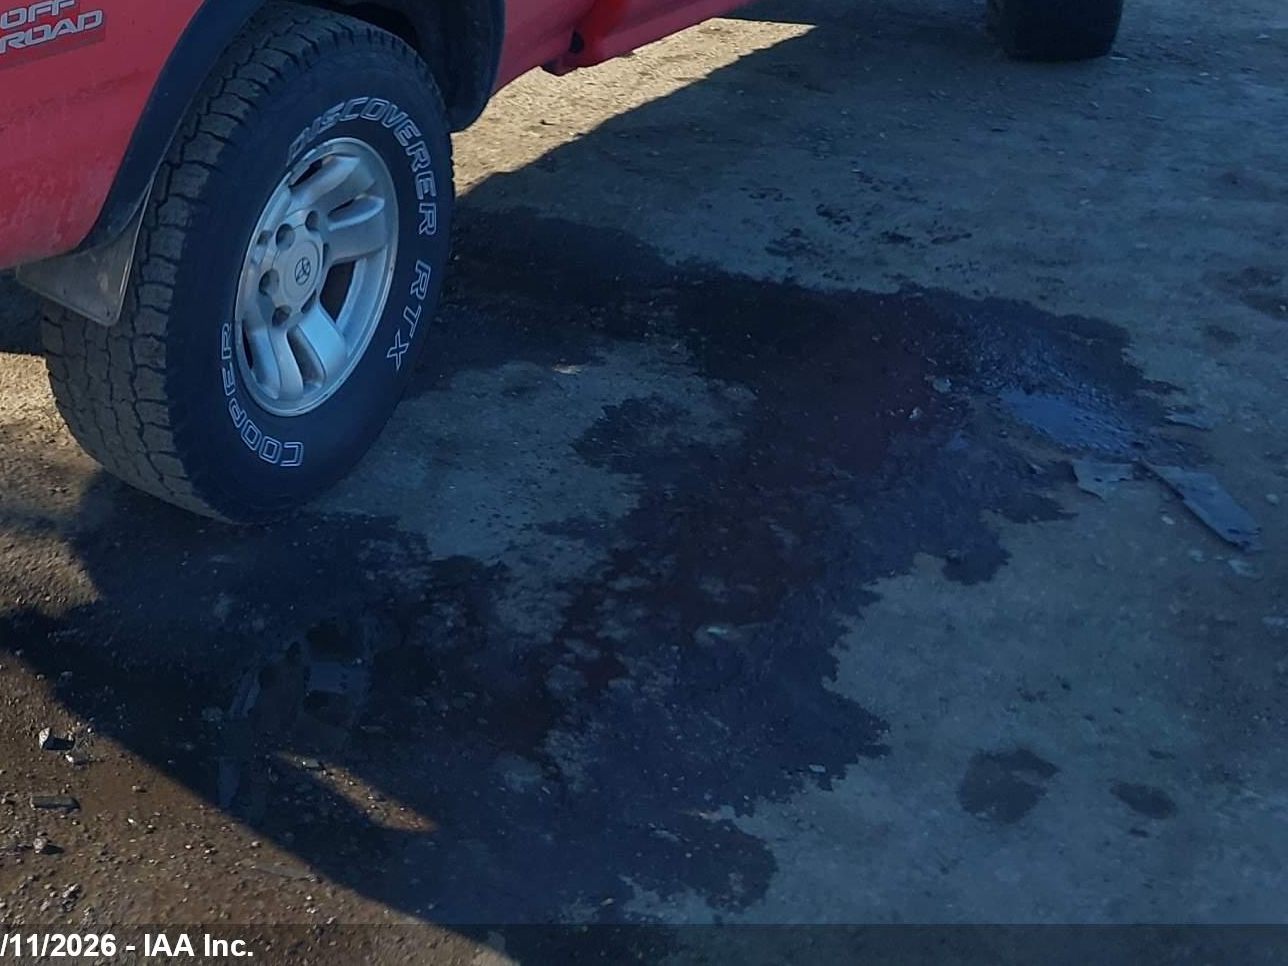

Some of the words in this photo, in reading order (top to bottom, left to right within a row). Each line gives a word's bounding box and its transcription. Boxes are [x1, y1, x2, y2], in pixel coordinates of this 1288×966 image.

[287, 97, 437, 235] DISCOVERER
[386, 259, 431, 371] RTX
[221, 322, 304, 467] COOPER
